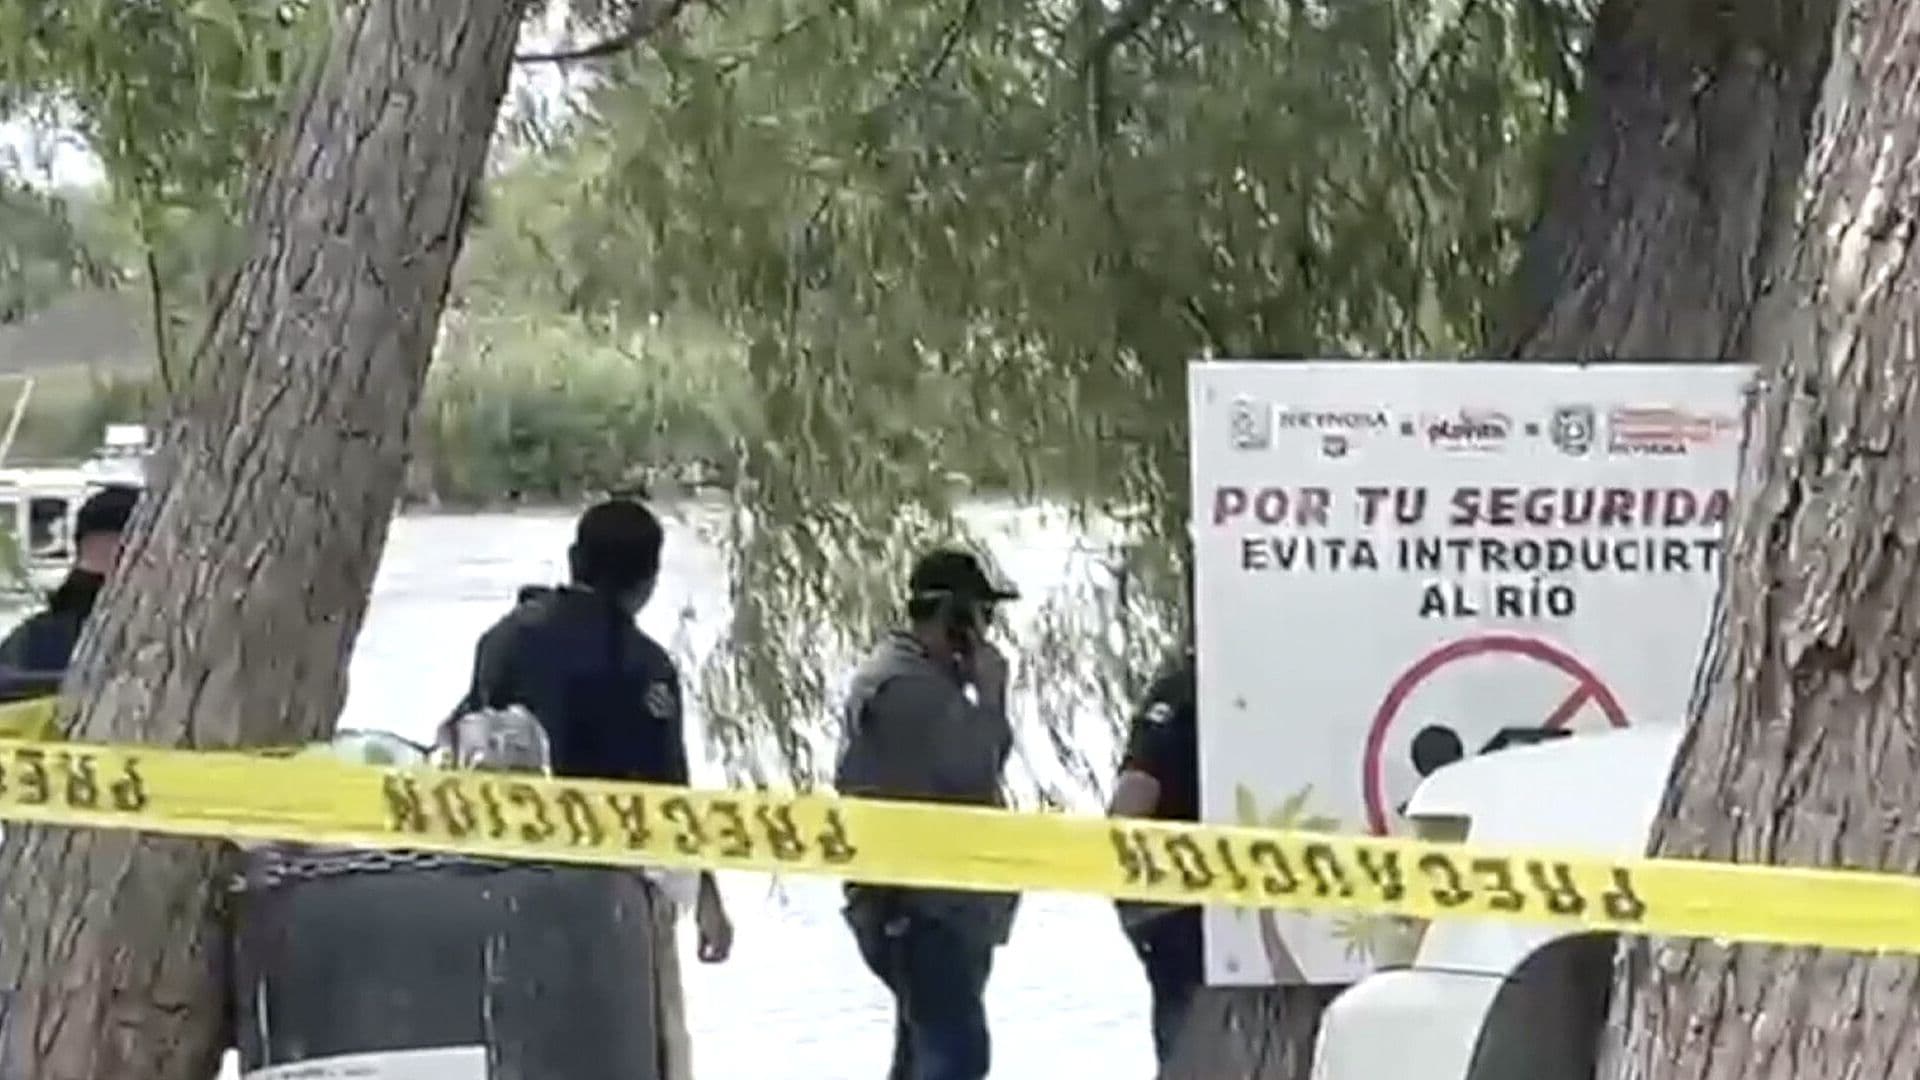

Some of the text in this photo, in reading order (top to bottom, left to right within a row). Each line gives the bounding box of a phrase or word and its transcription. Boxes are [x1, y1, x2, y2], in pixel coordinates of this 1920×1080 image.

[1213, 486, 1331, 526] POR
[1355, 486, 1426, 525] TU
[1242, 537, 1377, 571] EVITA
[1419, 576, 1576, 617] AL RÍO
[0, 748, 146, 811] PRE
[383, 774, 857, 863] PRECAUCION
[1110, 828, 1646, 921] PRECAUCION
